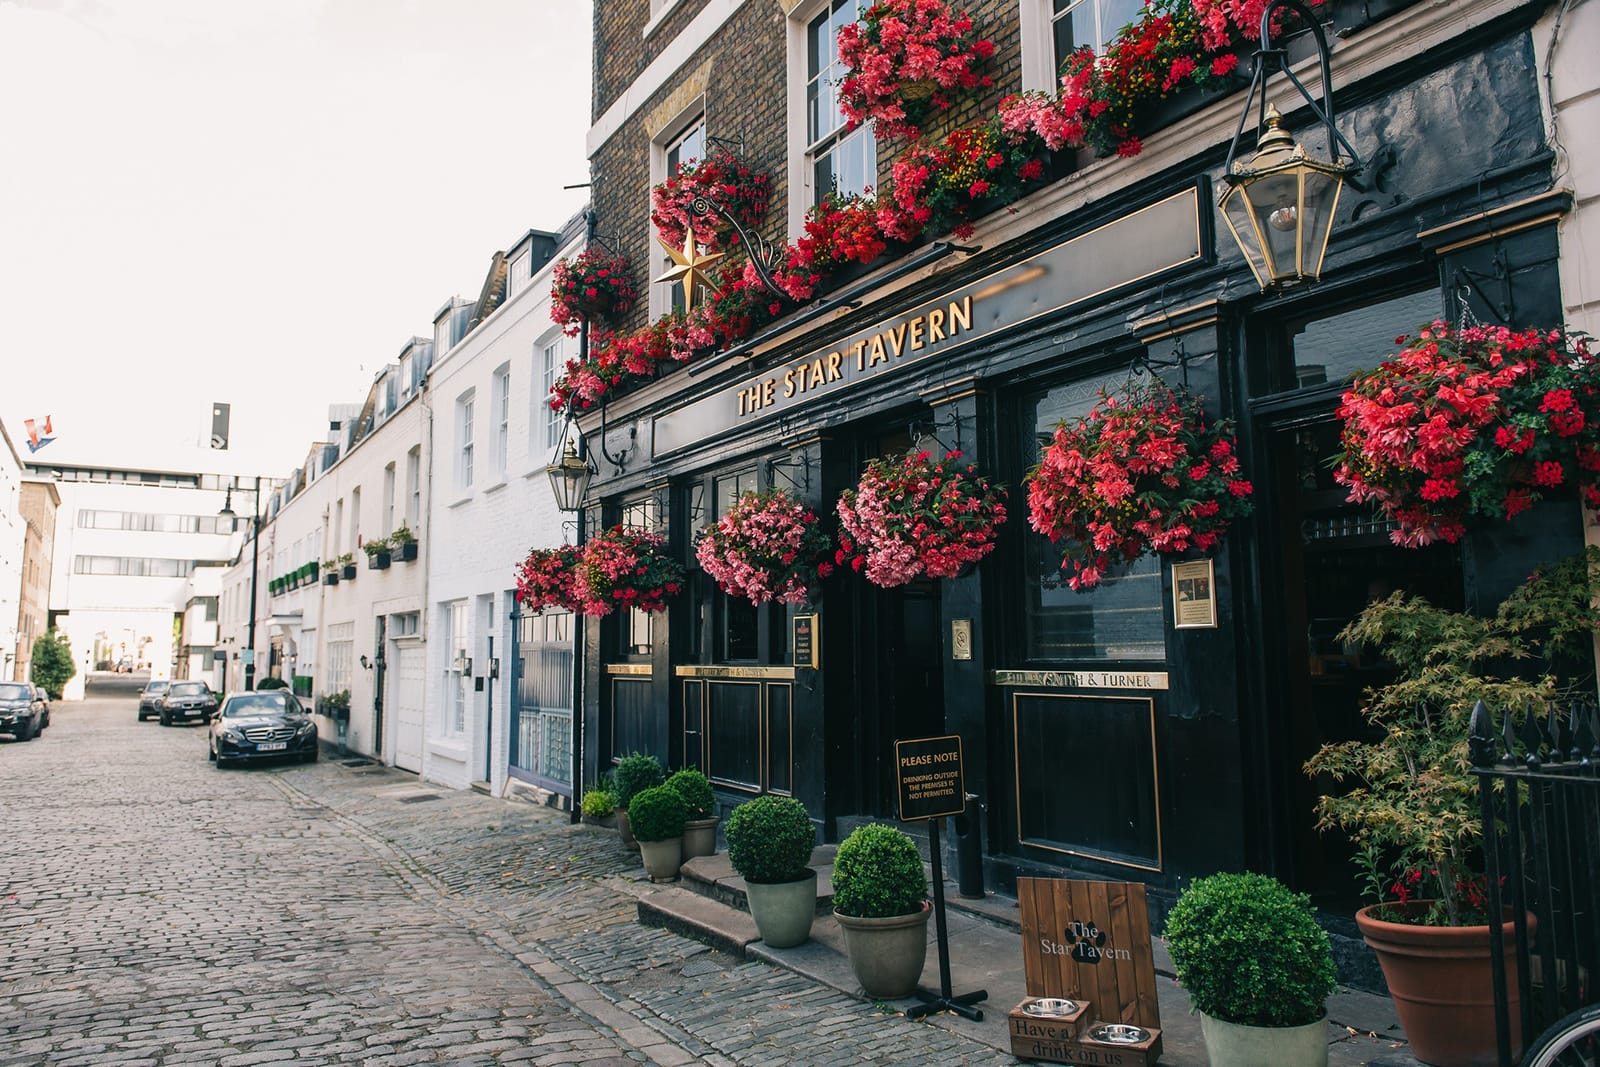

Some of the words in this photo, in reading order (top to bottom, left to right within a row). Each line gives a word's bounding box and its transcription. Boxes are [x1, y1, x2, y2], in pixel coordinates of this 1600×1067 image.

[737, 378, 776, 416] THE
[783, 351, 843, 398] STAR
[855, 295, 974, 372] TAVERN
[1087, 673, 1098, 686] &
[1101, 673, 1152, 688] TURNER
[901, 755, 932, 767] PLEASE
[934, 752, 959, 762] NOTE
[904, 775, 932, 783] DRINKING
[934, 771, 958, 780] OUTSIDE
[1068, 921, 1099, 938] The
[1041, 939, 1072, 955] Star
[1075, 942, 1131, 960] Tavern
[1015, 1020, 1056, 1038] Have
[1060, 1028, 1070, 1039] a
[1032, 1041, 1073, 1060] drink
[1078, 1051, 1099, 1064] on
[1104, 1053, 1123, 1065] us
